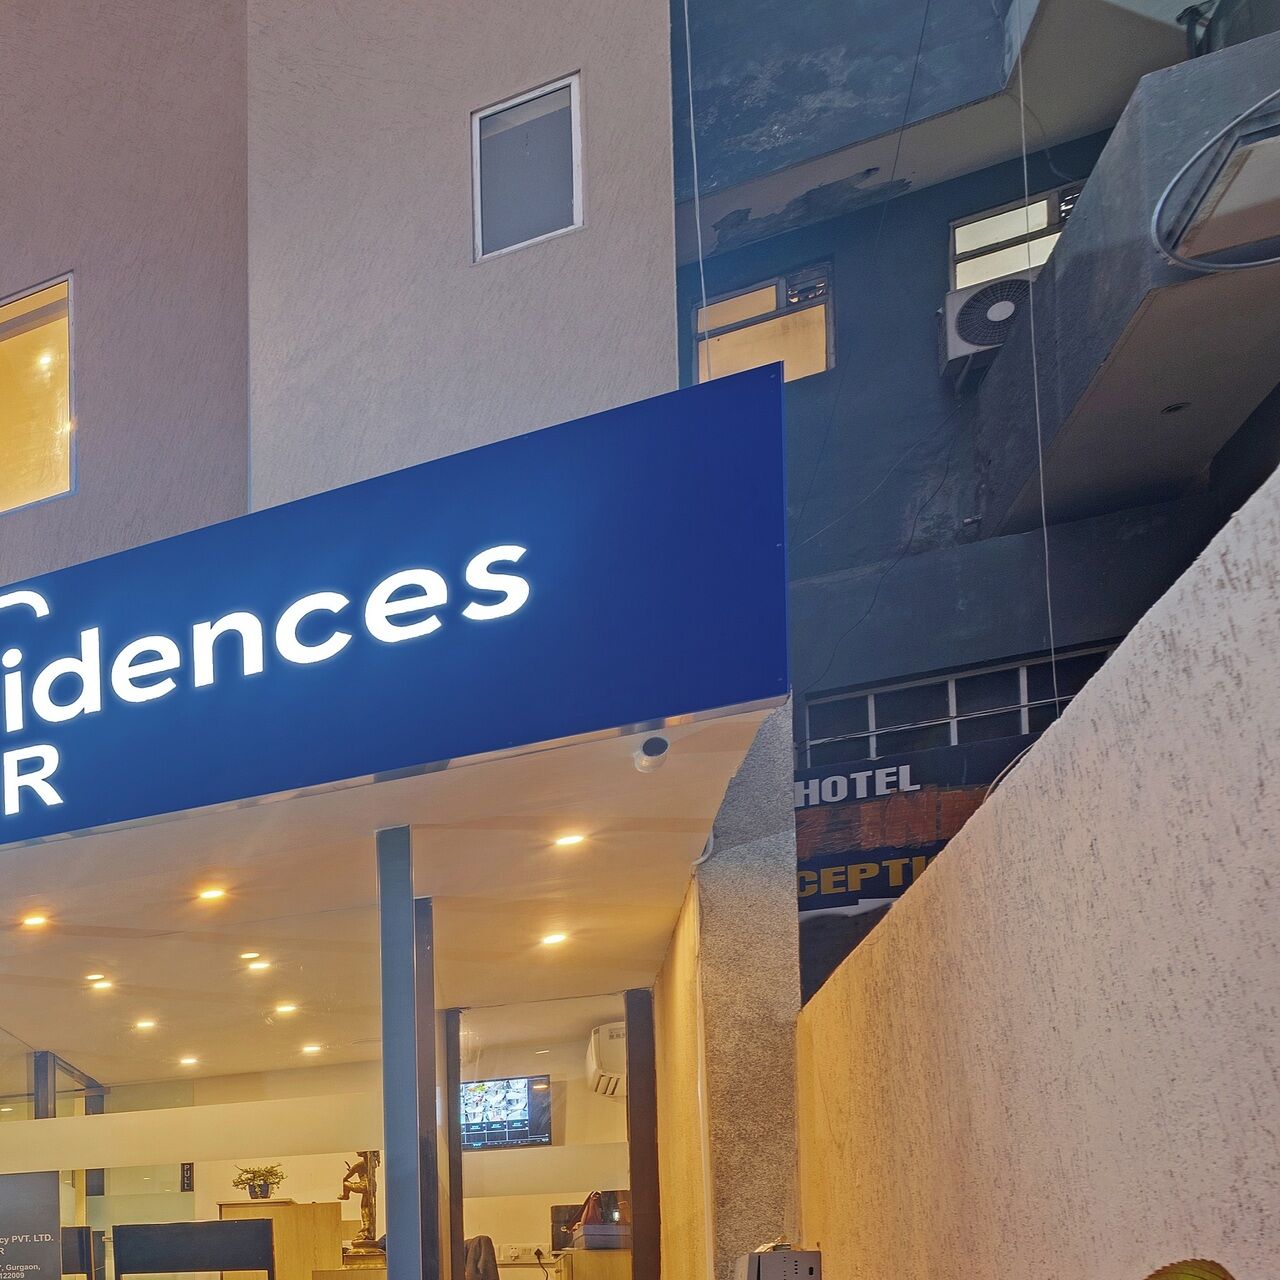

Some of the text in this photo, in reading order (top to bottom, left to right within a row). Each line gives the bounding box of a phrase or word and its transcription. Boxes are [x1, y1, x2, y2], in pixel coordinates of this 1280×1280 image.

[794, 765, 920, 807] HOTEL
[797, 855, 936, 898] CEPTI
[11, 1235, 31, 1243] PVT.
[33, 1233, 54, 1242] LTD.
[5, 1264, 41, 1272] Gurgaon,
